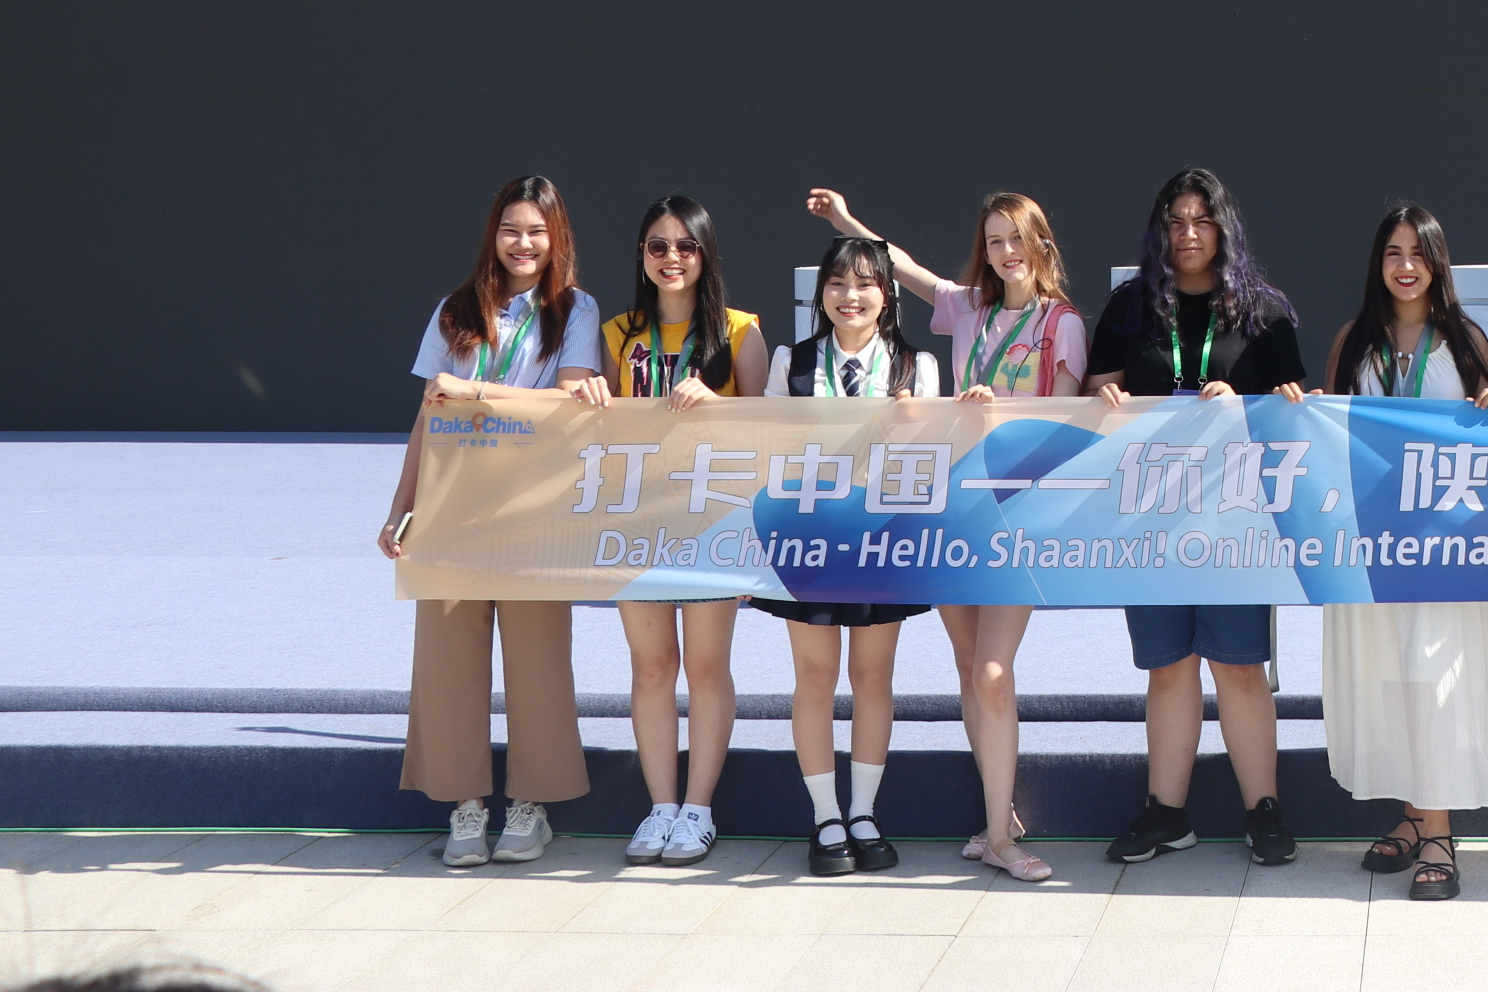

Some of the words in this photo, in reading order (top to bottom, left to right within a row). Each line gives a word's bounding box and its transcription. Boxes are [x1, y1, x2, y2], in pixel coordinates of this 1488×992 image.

[429, 416, 473, 434] Daka
[459, 439, 498, 447] 打卡中国
[594, 527, 700, 567] Daka
[986, 528, 1168, 569] Shaanxi!
[1177, 527, 1323, 568] Online
